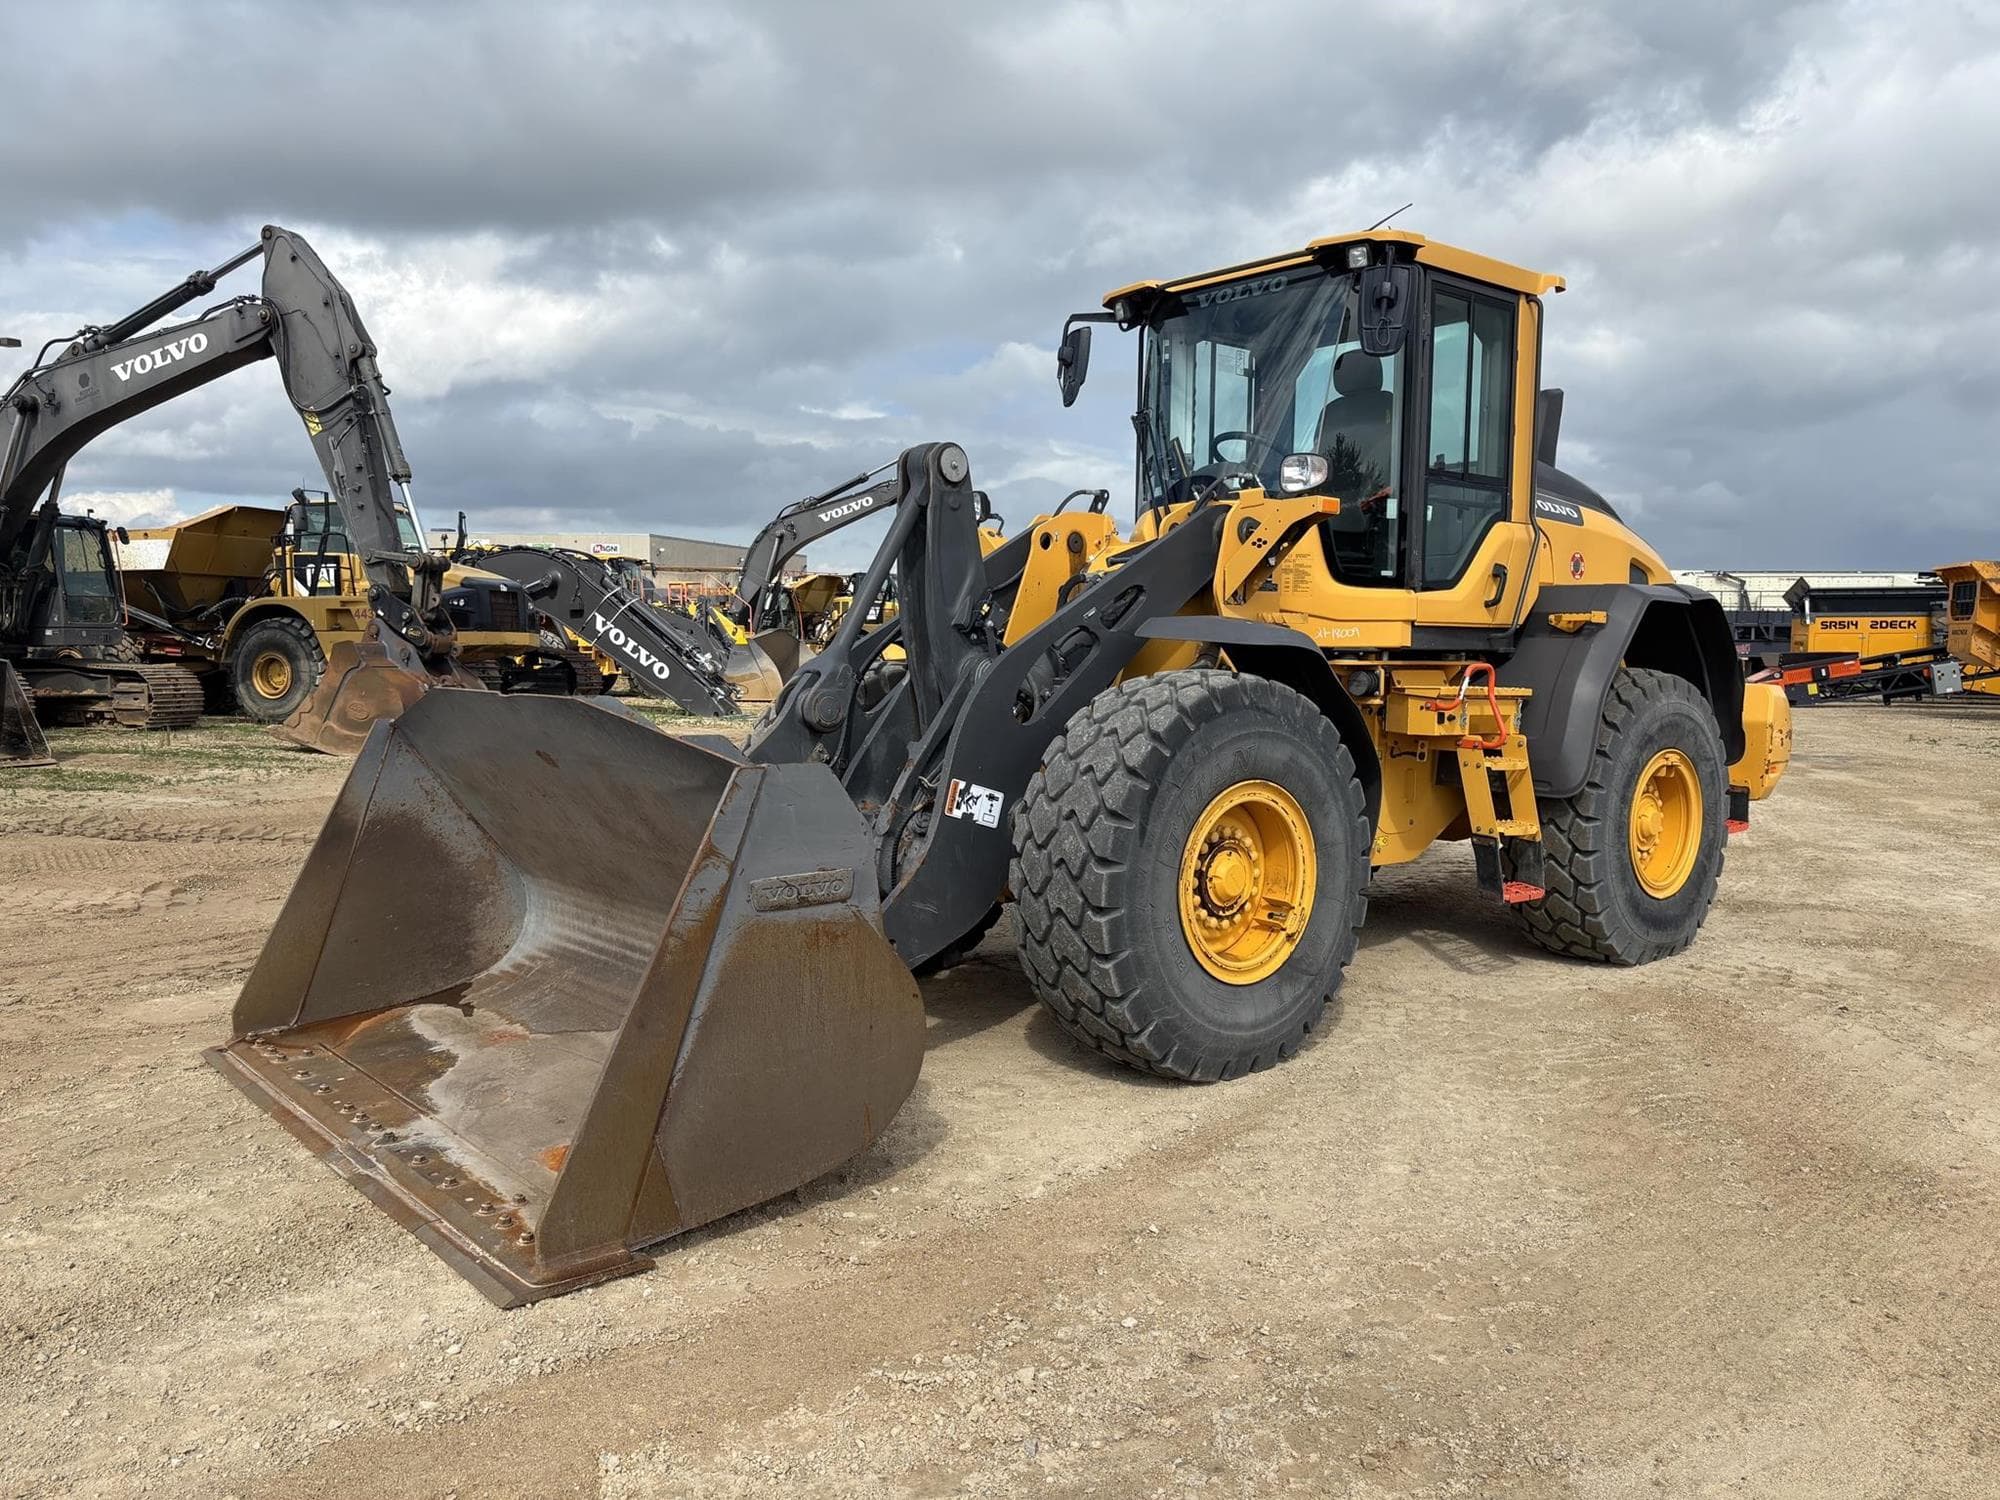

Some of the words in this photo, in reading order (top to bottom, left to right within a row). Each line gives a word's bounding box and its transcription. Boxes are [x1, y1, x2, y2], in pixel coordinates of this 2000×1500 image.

[1197, 275, 1289, 308] VOLVO
[110, 333, 208, 382] VOLVO
[818, 496, 873, 522] VOLVO
[1535, 500, 1578, 518] OLVO
[1870, 620, 1917, 630] 2DECK
[594, 612, 670, 679] VOLVO
